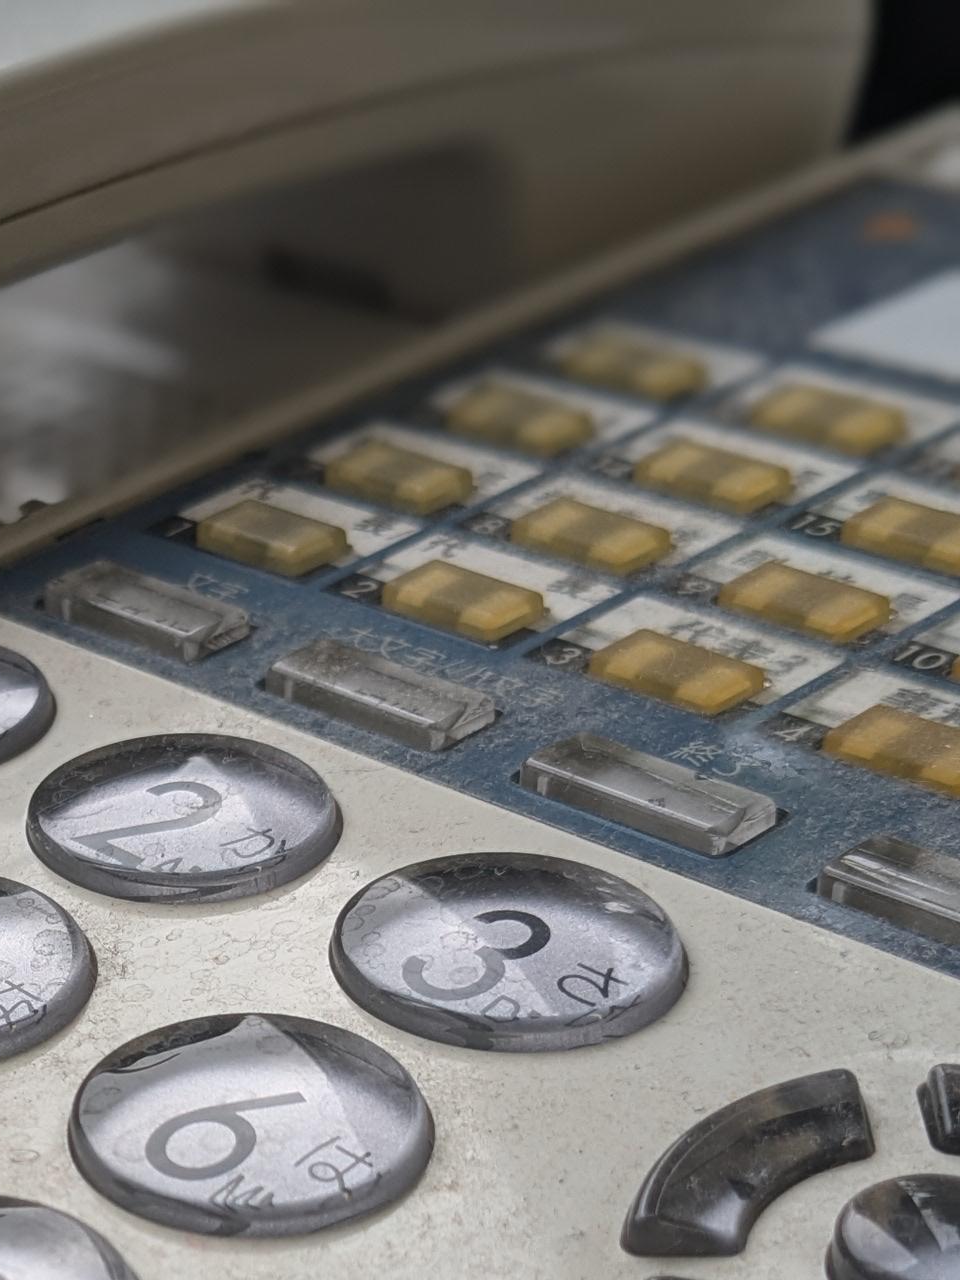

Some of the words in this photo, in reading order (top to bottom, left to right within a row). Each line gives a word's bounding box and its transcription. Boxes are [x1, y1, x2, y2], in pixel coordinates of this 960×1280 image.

[791, 514, 835, 537] 15
[341, 580, 380, 600] 2
[544, 647, 584, 666] 3
[893, 642, 948, 671] 10
[772, 724, 815, 743] 4
[70, 780, 222, 869] 2
[401, 909, 551, 1001] 3
[143, 1090, 309, 1181] 6
